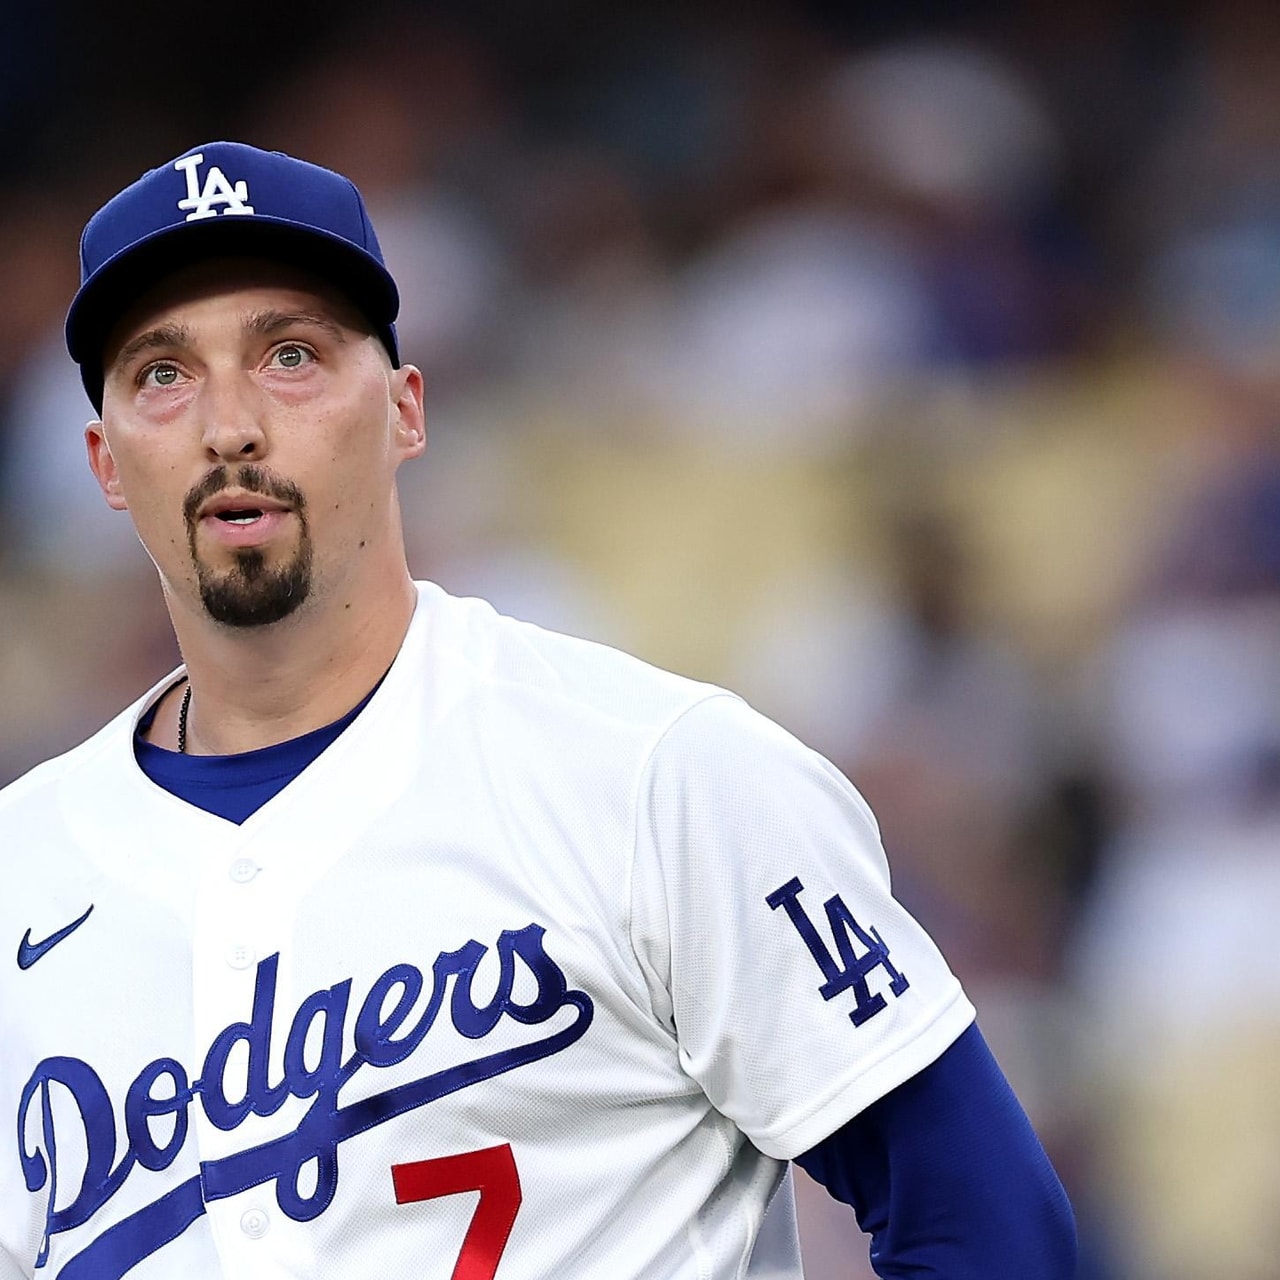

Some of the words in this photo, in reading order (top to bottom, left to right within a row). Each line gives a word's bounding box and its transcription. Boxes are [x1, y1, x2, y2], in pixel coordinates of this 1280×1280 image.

[175, 153, 254, 222] LA
[765, 876, 910, 1028] LA
[17, 922, 582, 1268] Dodgers
